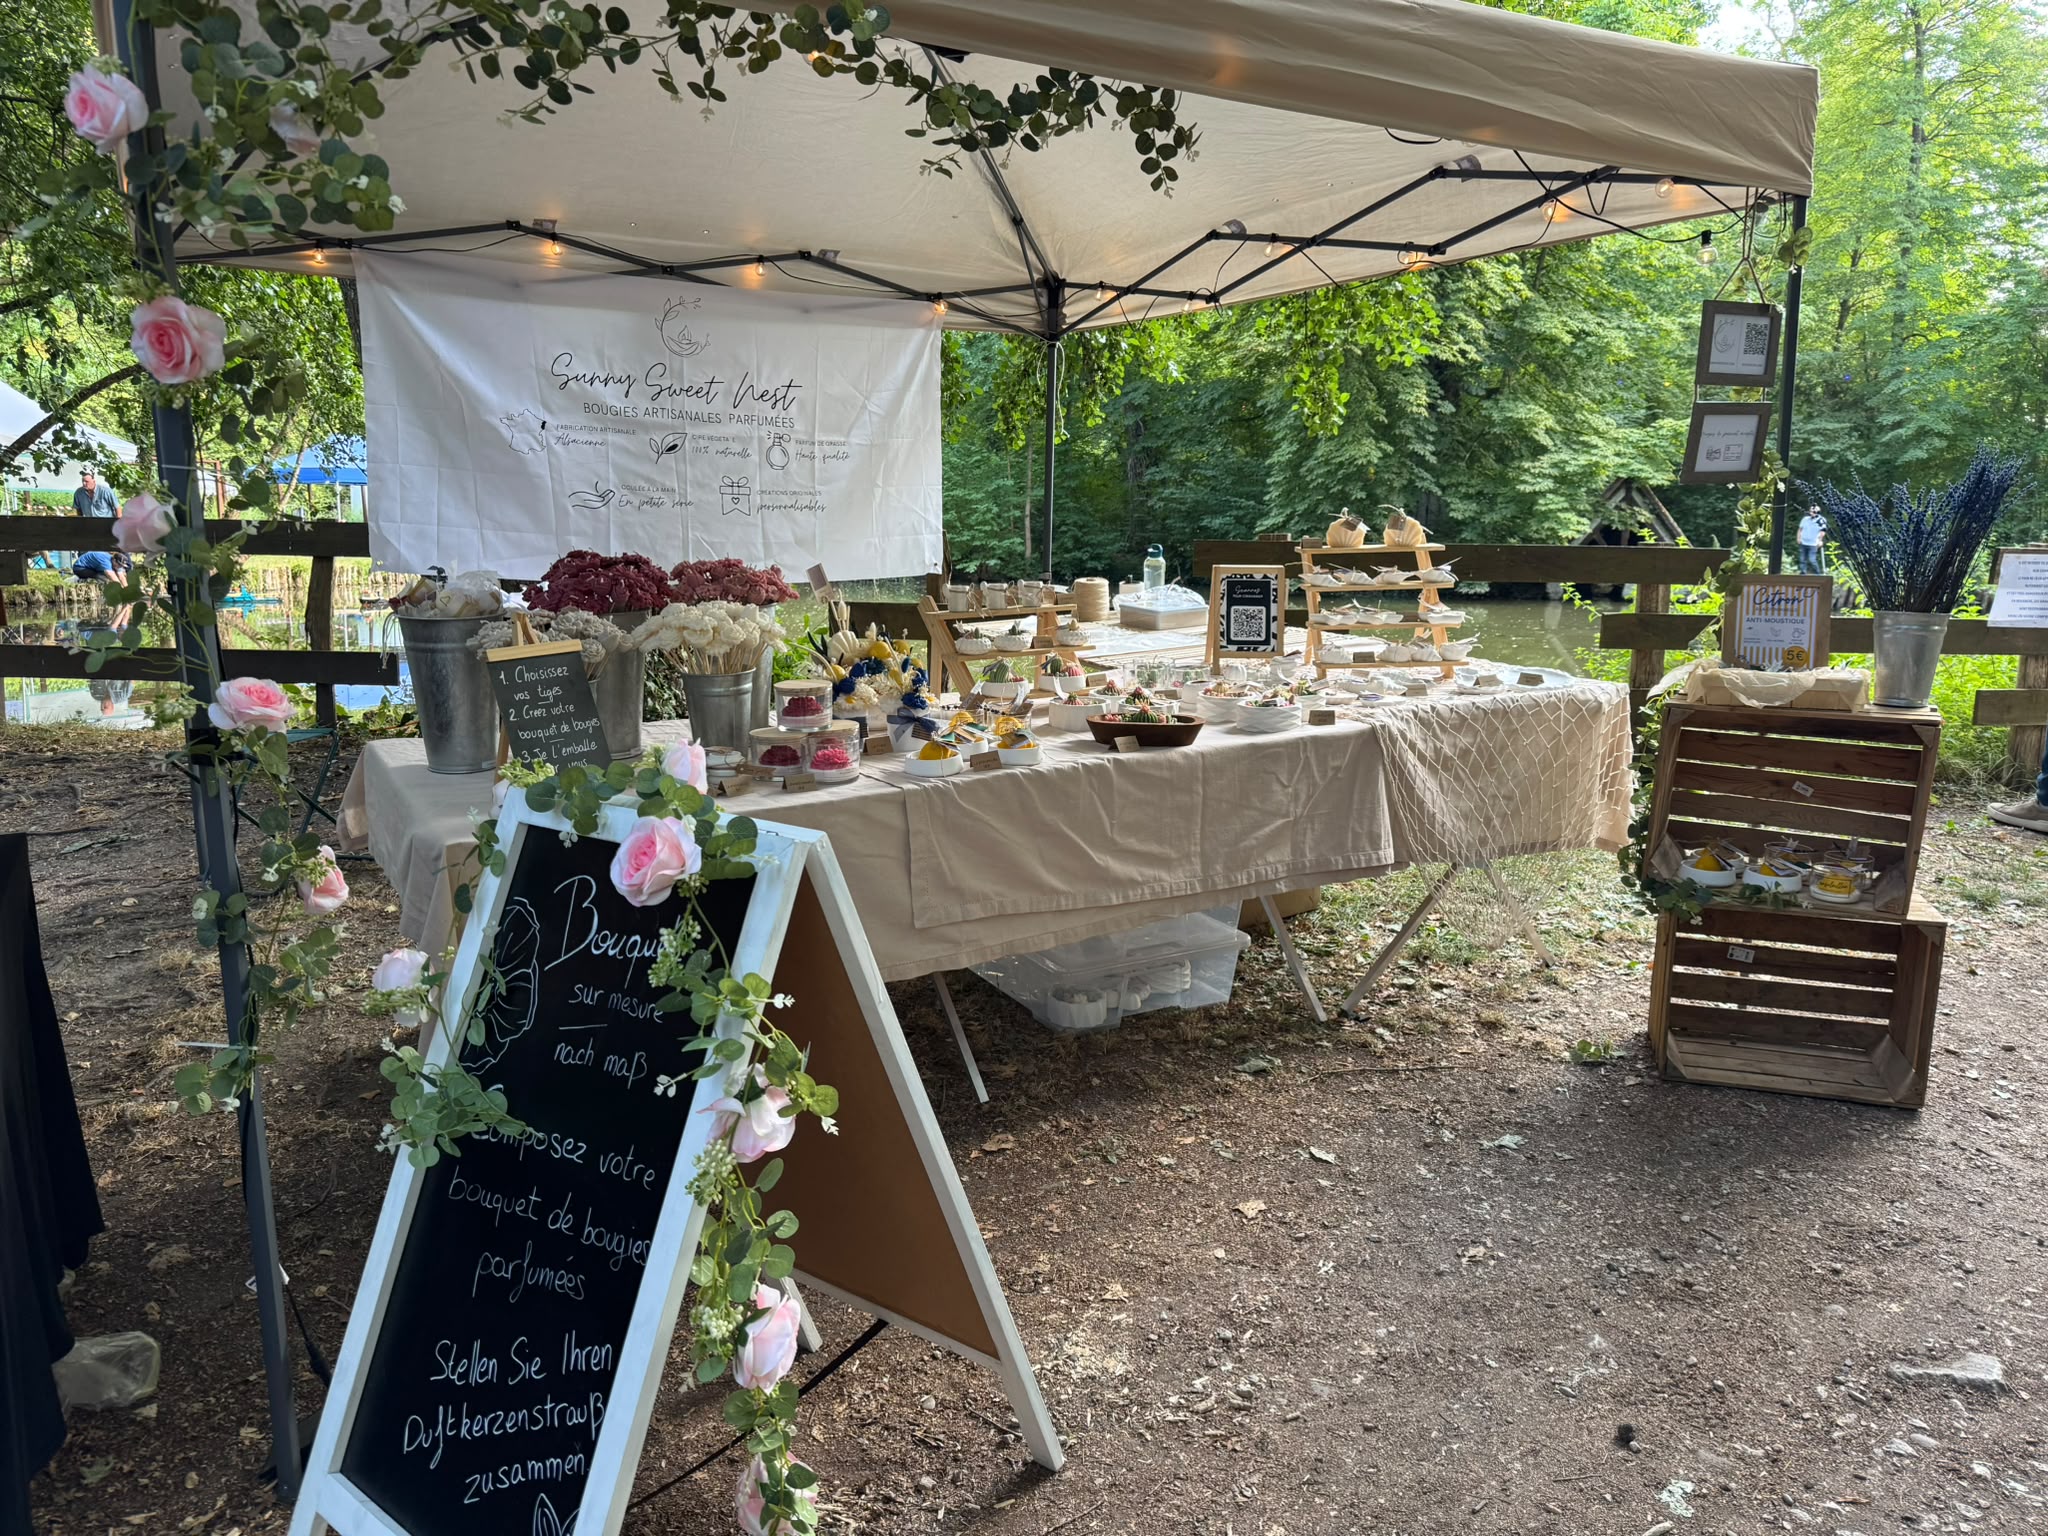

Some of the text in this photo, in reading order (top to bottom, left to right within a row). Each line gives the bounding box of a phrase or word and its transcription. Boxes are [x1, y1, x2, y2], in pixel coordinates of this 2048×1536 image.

[551, 352, 803, 411] Sunny Sweet Nest
[583, 402, 795, 429] BOUGIES ARTISANALES PARFUMÉES
[554, 432, 607, 447] Alsacienne
[556, 423, 637, 436] FABRICATION ARTISANALE
[715, 446, 752, 459] naturelle
[795, 447, 850, 464] Haute qualité
[618, 494, 634, 508] En
[638, 496, 667, 511] petite
[756, 498, 827, 514] personnalisables
[1753, 587, 1804, 607] Citron
[1764, 617, 1805, 625] MOUSTIQUE
[1786, 650, 1804, 661] 5€
[499, 665, 570, 685] 1. Choisissez
[514, 684, 563, 702] vos tiges
[509, 708, 520, 722] 2.
[551, 702, 576, 715] votre
[517, 715, 600, 743] bouquet de bougies
[533, 748, 548, 761] Je
[552, 740, 598, 759] l'emballe
[544, 874, 680, 989] Bouqu
[568, 983, 664, 1024] sur mesure
[554, 1037, 648, 1090] nach maß
[600, 1144, 656, 1191] votre
[448, 1165, 651, 1272] bouquet de bougies
[472, 1240, 586, 1303] parfumées
[430, 1329, 612, 1387] Stellen Sie Ihren
[403, 1391, 605, 1470] Duftkerzenstrauß
